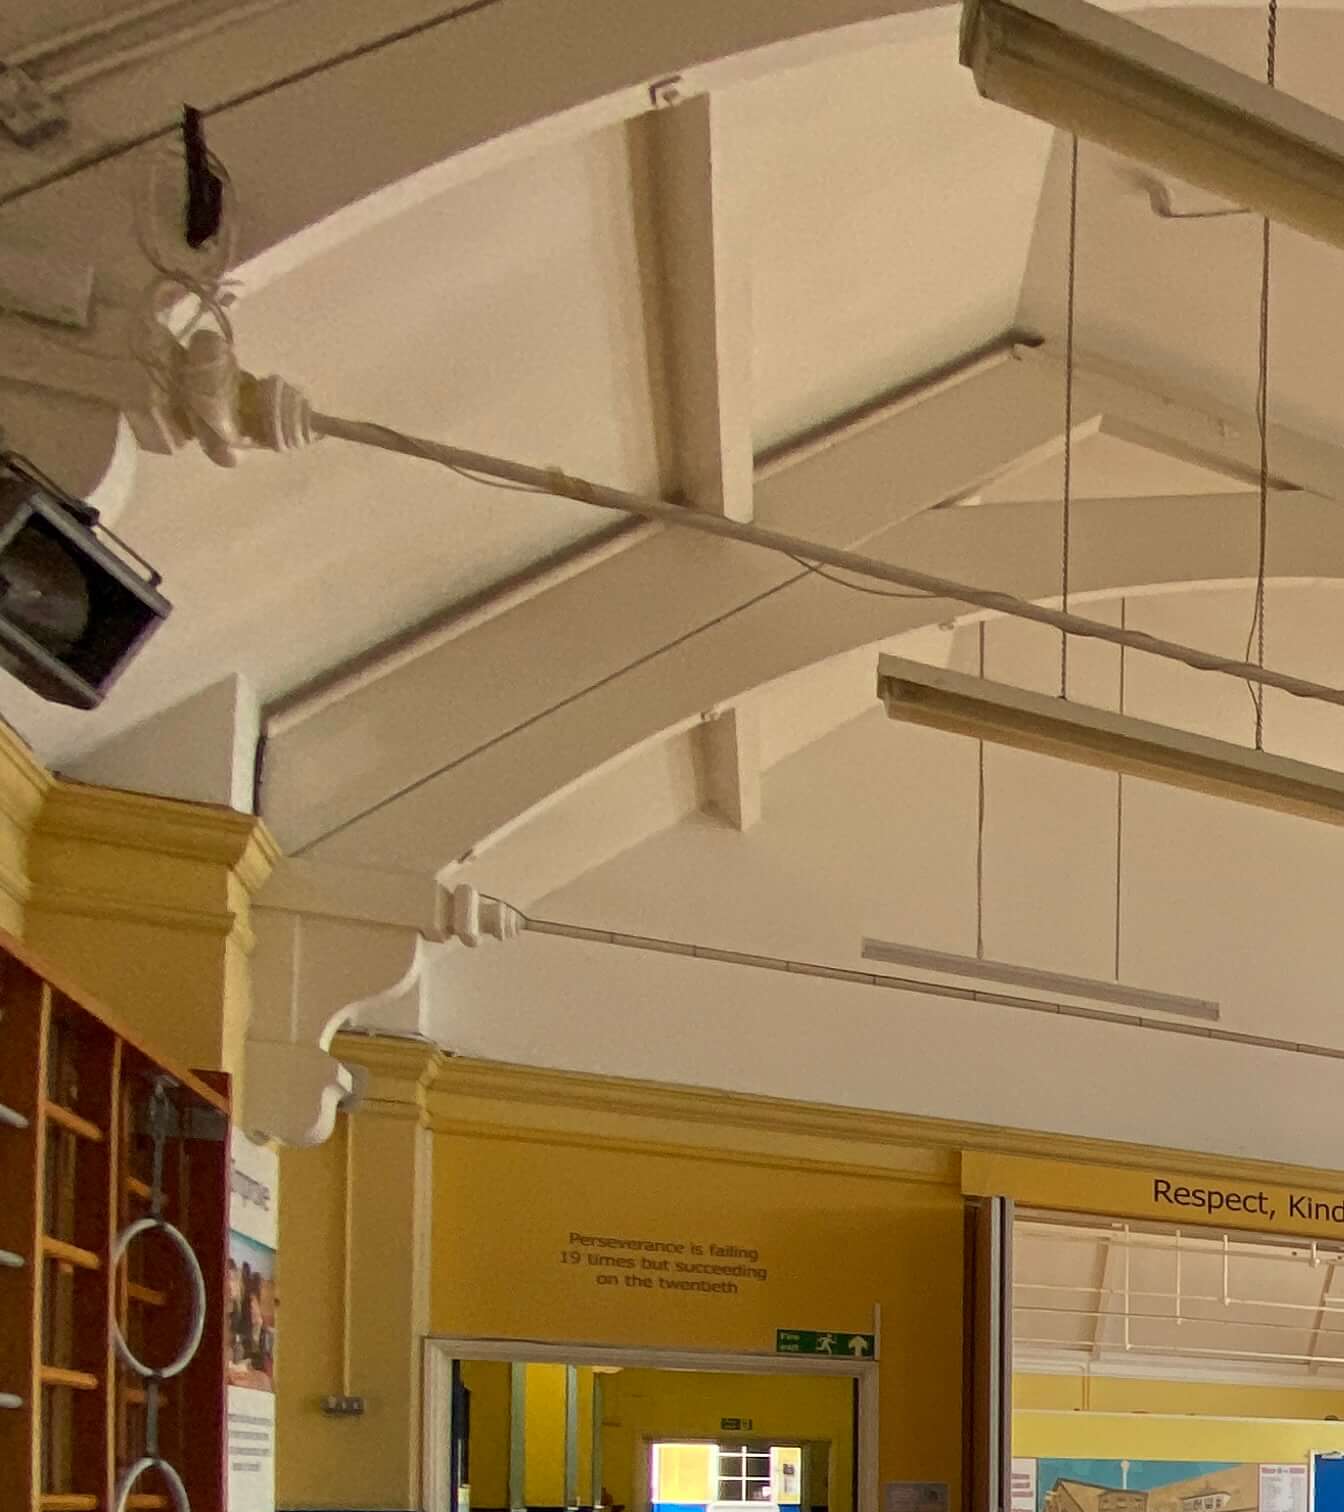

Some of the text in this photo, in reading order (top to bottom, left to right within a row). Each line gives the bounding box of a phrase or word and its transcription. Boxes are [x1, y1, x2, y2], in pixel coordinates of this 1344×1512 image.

[1153, 1178, 1276, 1220] Respect,
[569, 1232, 759, 1263] Perseverance is failing
[560, 1251, 768, 1281] 19 times but succeeding
[596, 1274, 618, 1285] on
[624, 1274, 653, 1288] the
